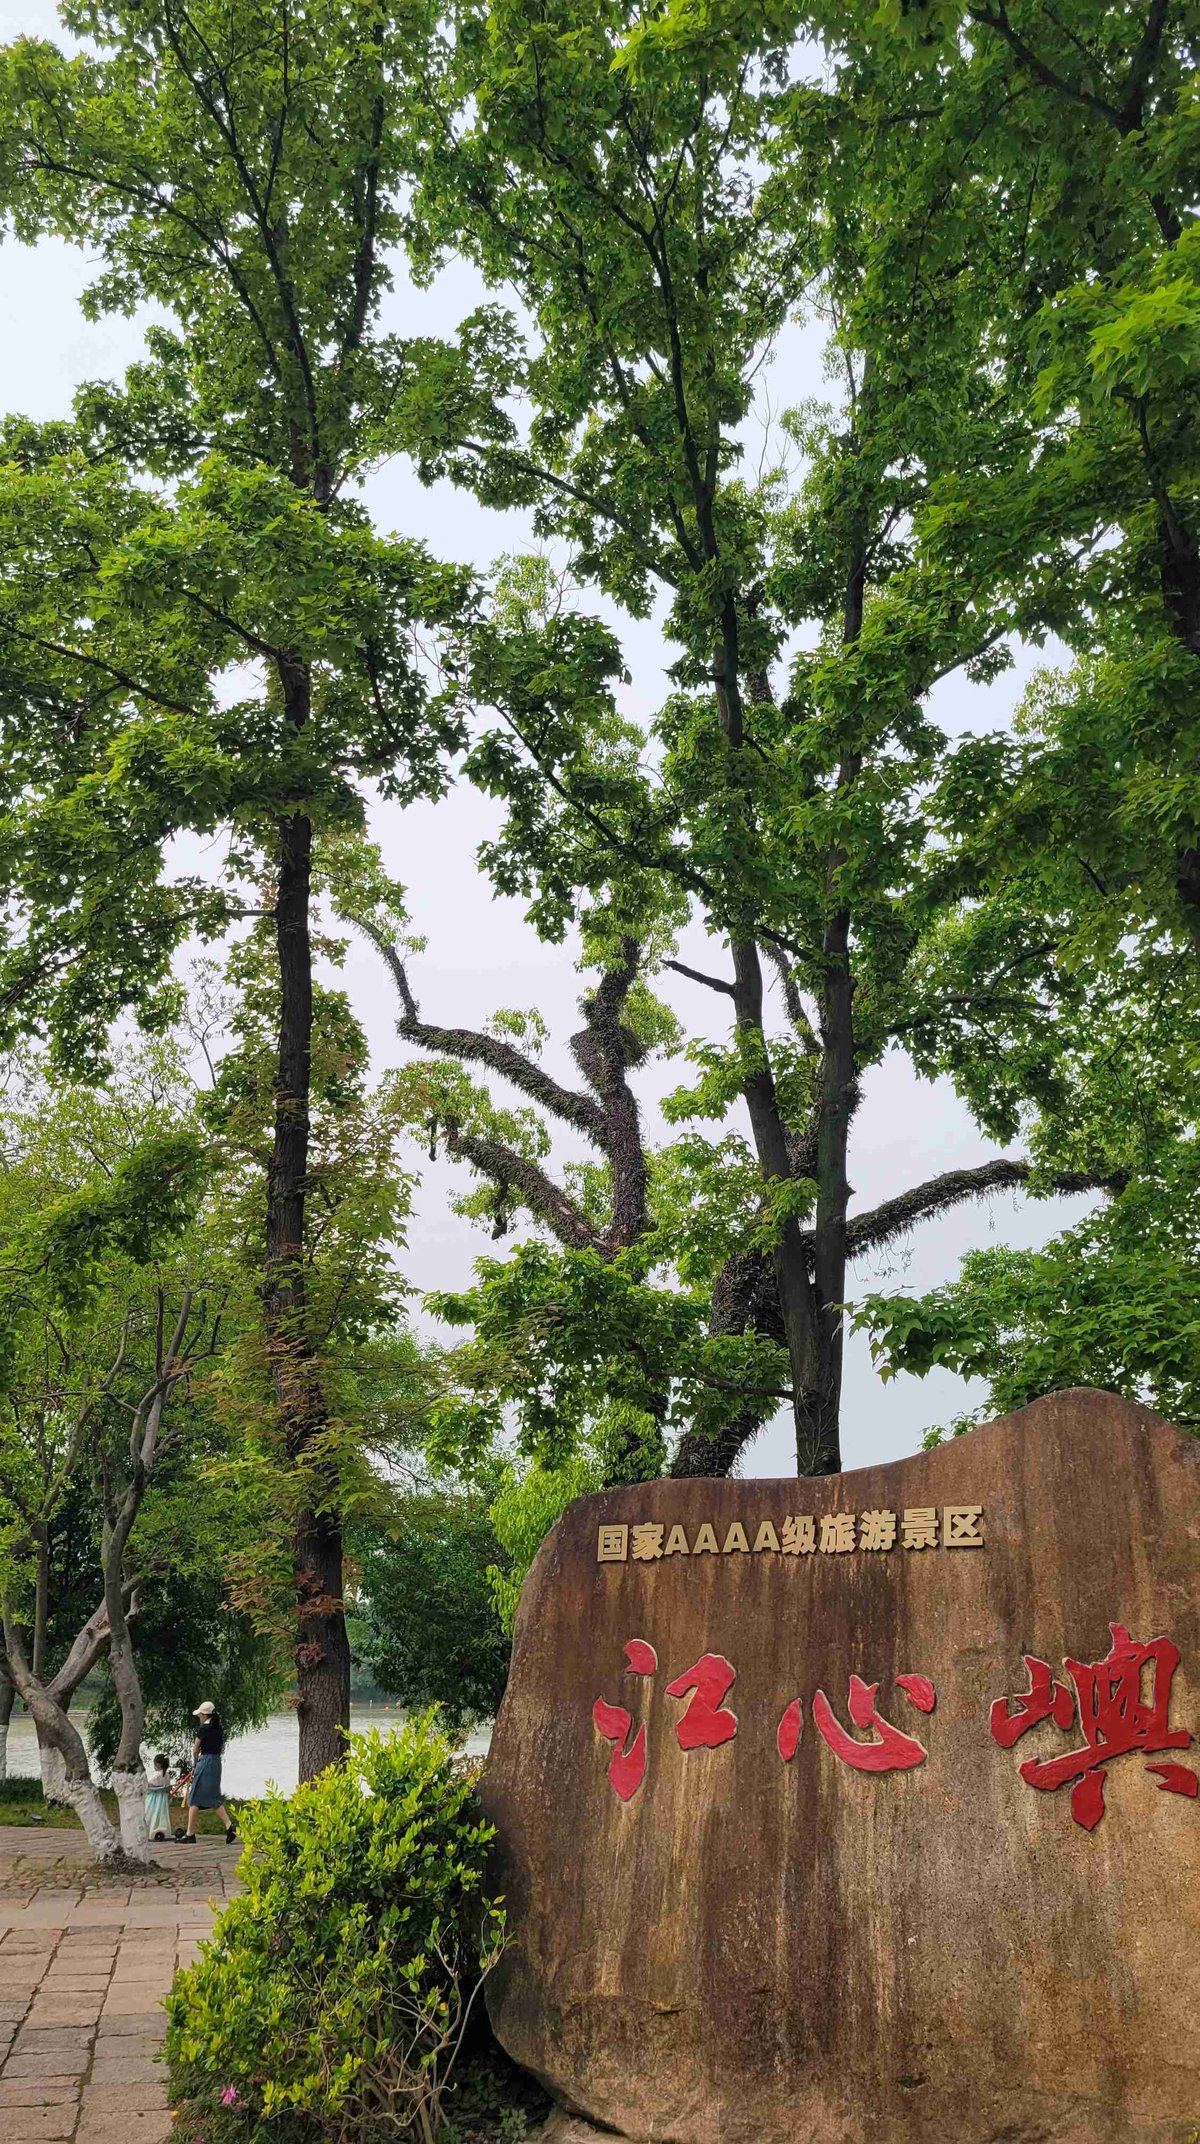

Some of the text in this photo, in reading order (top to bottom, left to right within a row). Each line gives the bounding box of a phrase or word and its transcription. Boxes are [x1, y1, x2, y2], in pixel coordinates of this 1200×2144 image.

[597, 1505, 984, 1562] 国家AAAA级旅游景区
